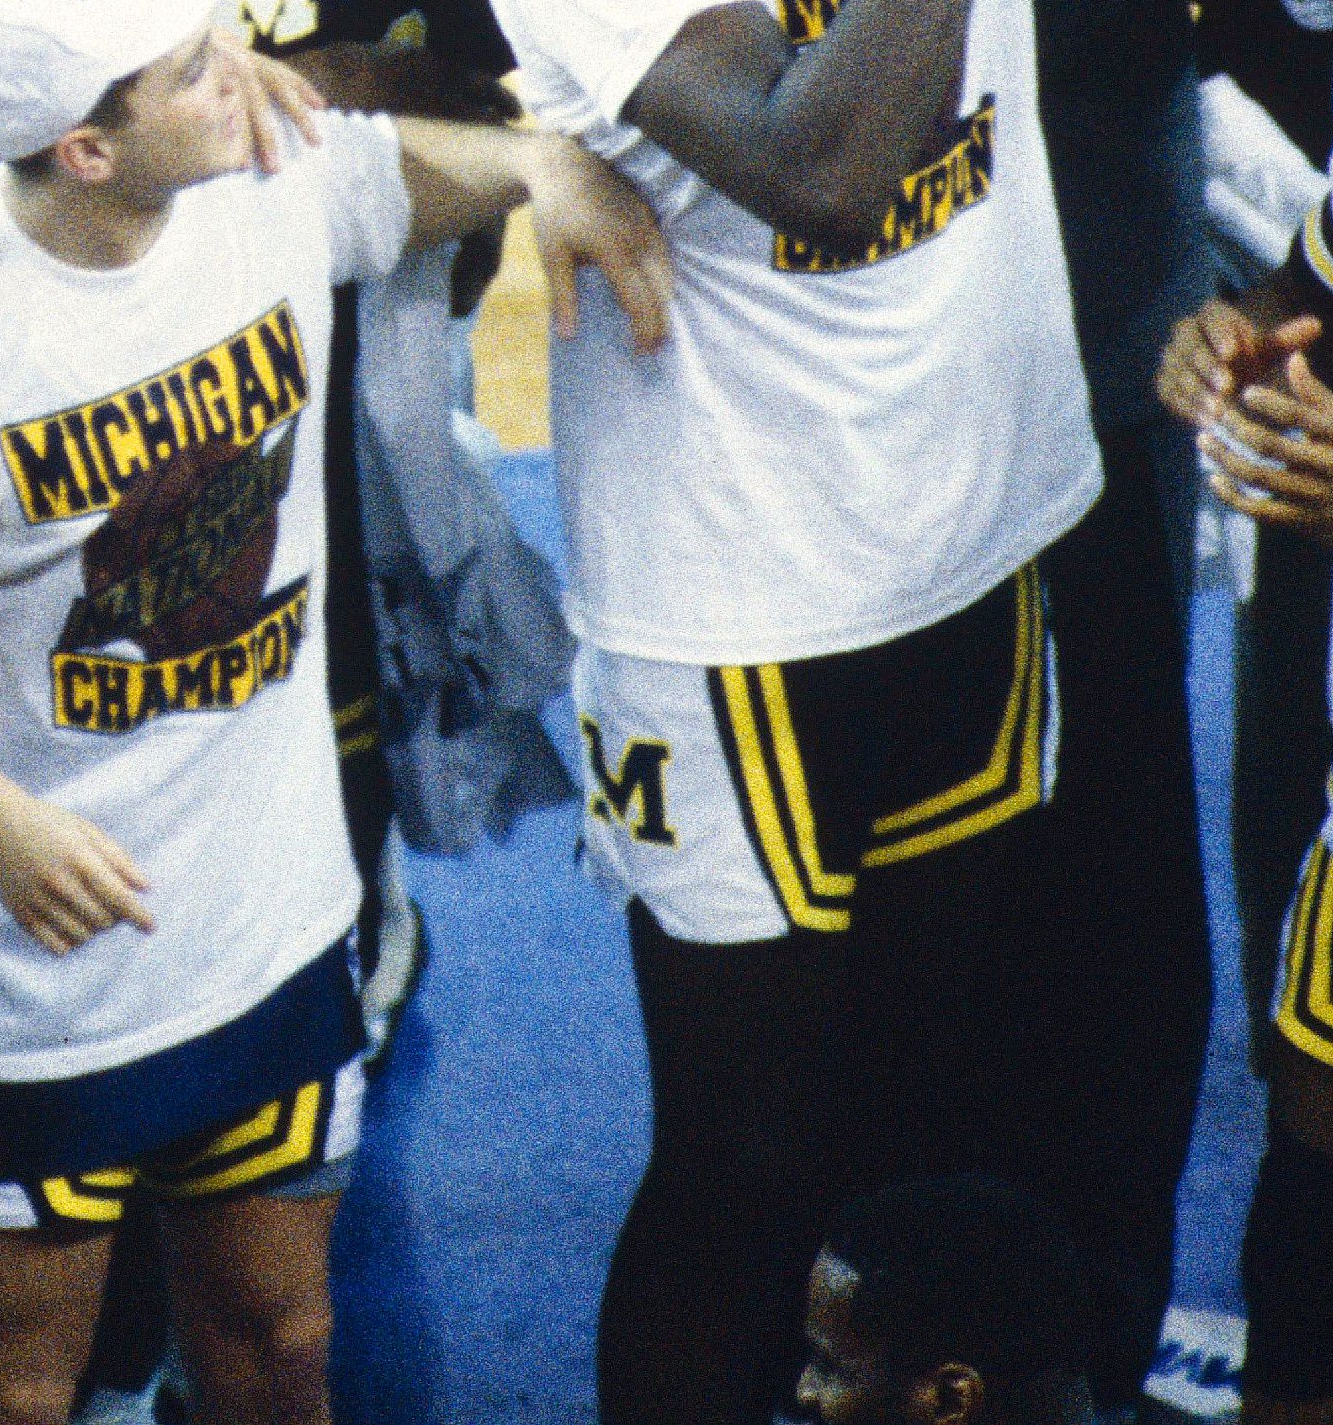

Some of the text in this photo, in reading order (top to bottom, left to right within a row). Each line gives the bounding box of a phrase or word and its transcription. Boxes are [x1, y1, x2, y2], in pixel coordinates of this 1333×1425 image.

[7, 304, 309, 519] MICHIGAN
[59, 597, 307, 732] CHAMPION
[579, 713, 679, 848] M
